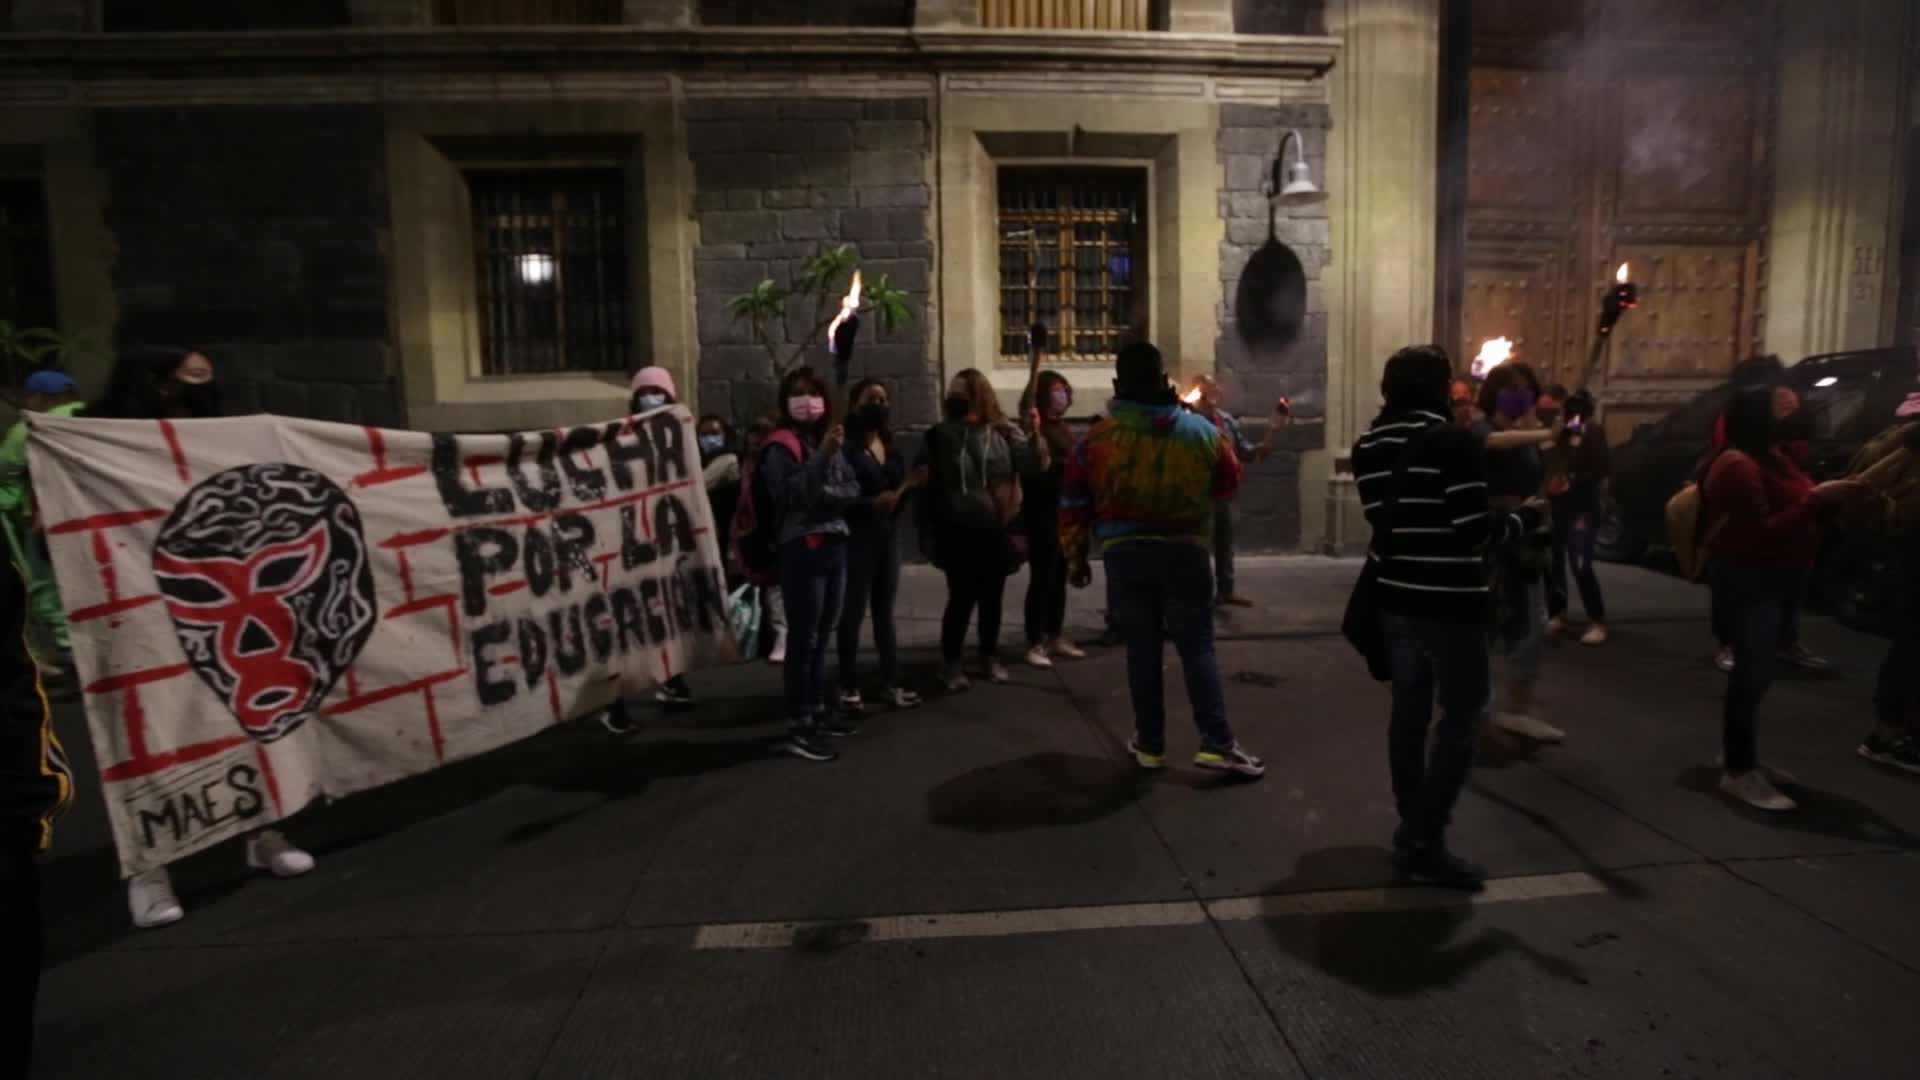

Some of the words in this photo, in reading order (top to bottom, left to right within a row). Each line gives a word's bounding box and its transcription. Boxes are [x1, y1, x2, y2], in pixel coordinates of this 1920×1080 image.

[432, 411, 686, 517] LUCHA
[455, 513, 597, 616] POR
[620, 494, 697, 570] LA
[139, 764, 263, 849] MAES
